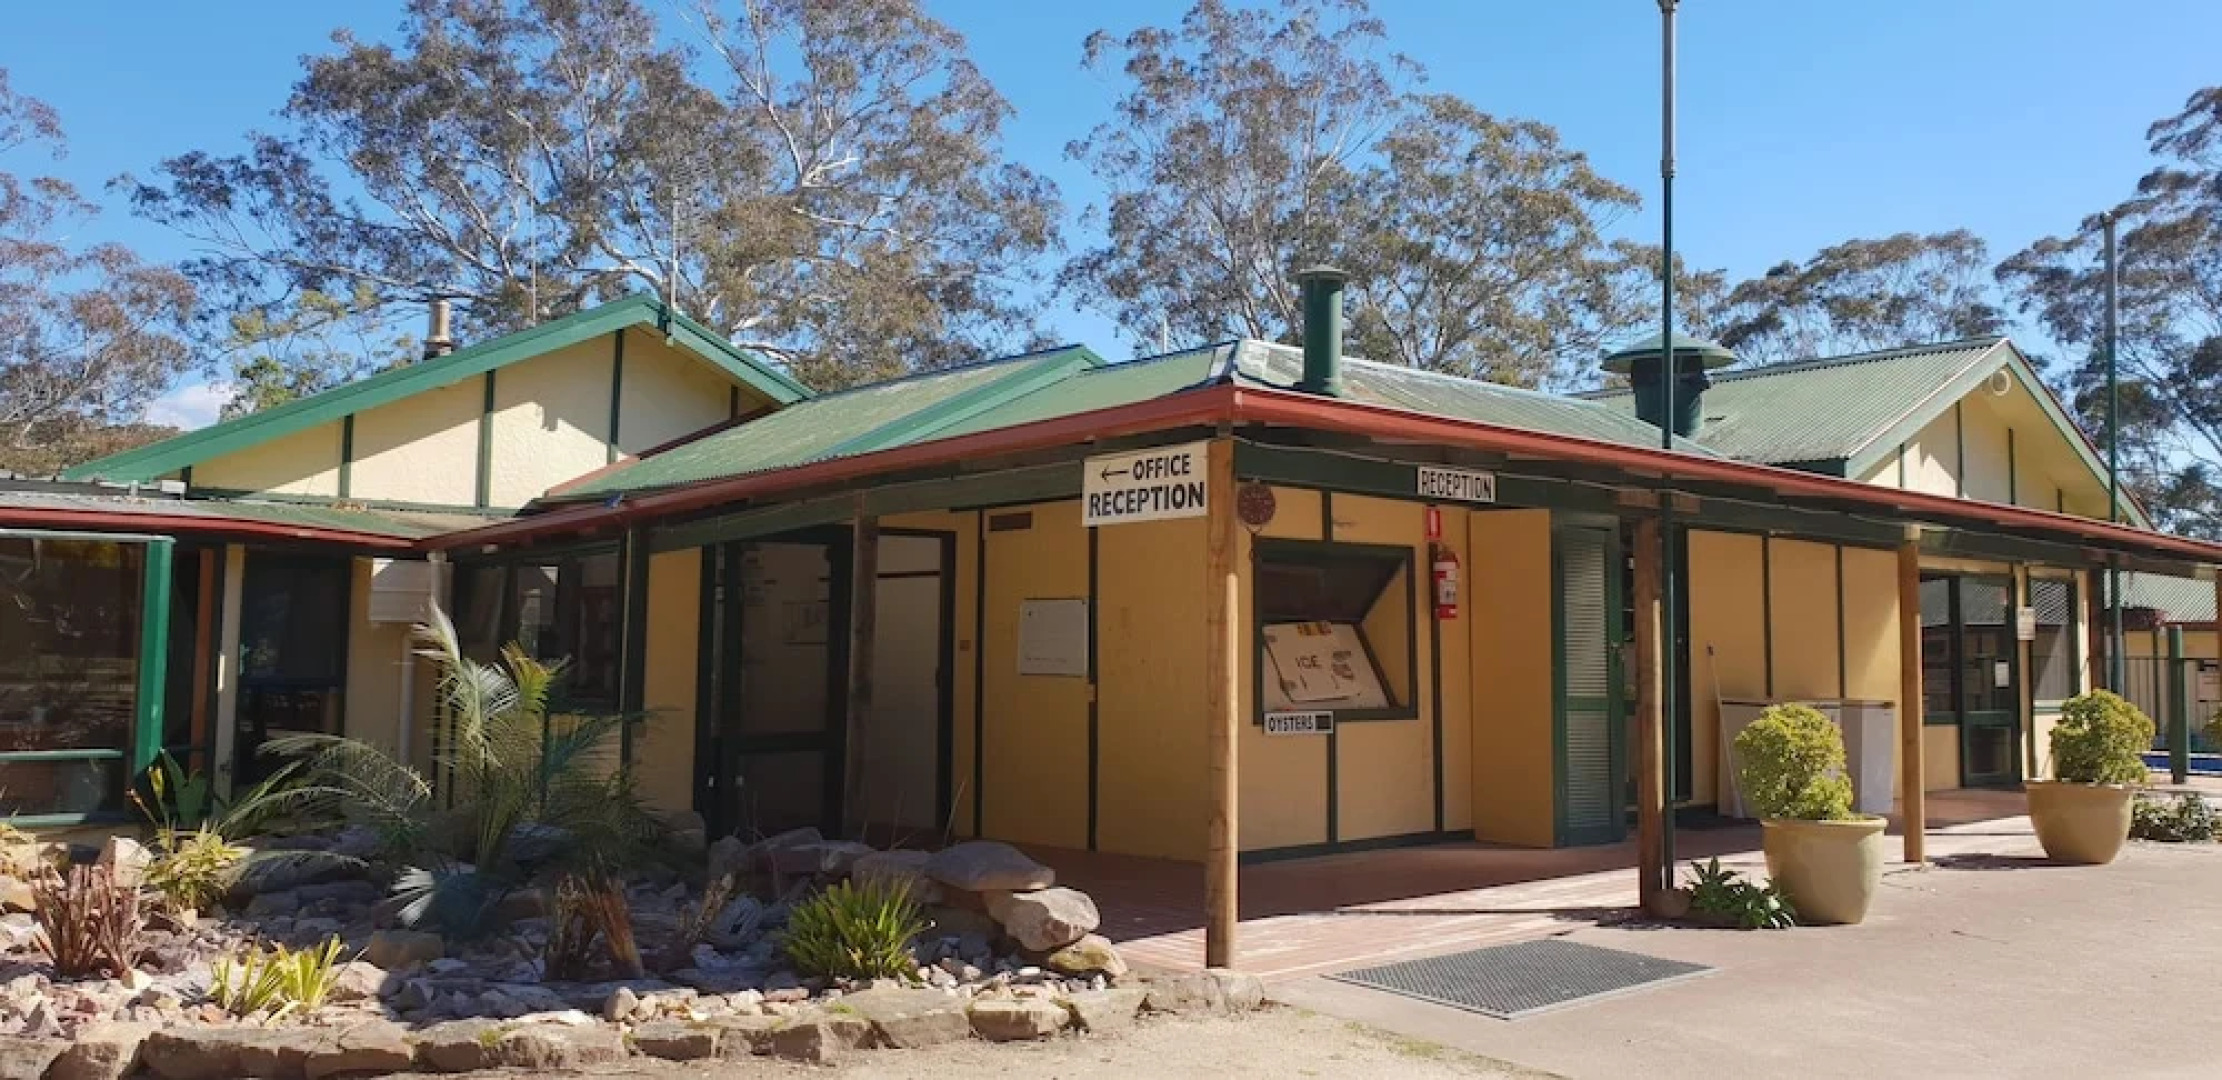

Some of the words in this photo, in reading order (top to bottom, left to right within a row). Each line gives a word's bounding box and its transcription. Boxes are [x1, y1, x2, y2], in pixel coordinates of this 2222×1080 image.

[1132, 453, 1191, 480] OFFICE
[1421, 470, 1492, 499] RECEPTION
[1088, 481, 1205, 518] RECEPTION
[1295, 655, 1322, 669] ICE
[1268, 715, 1313, 732] OYSTERS
